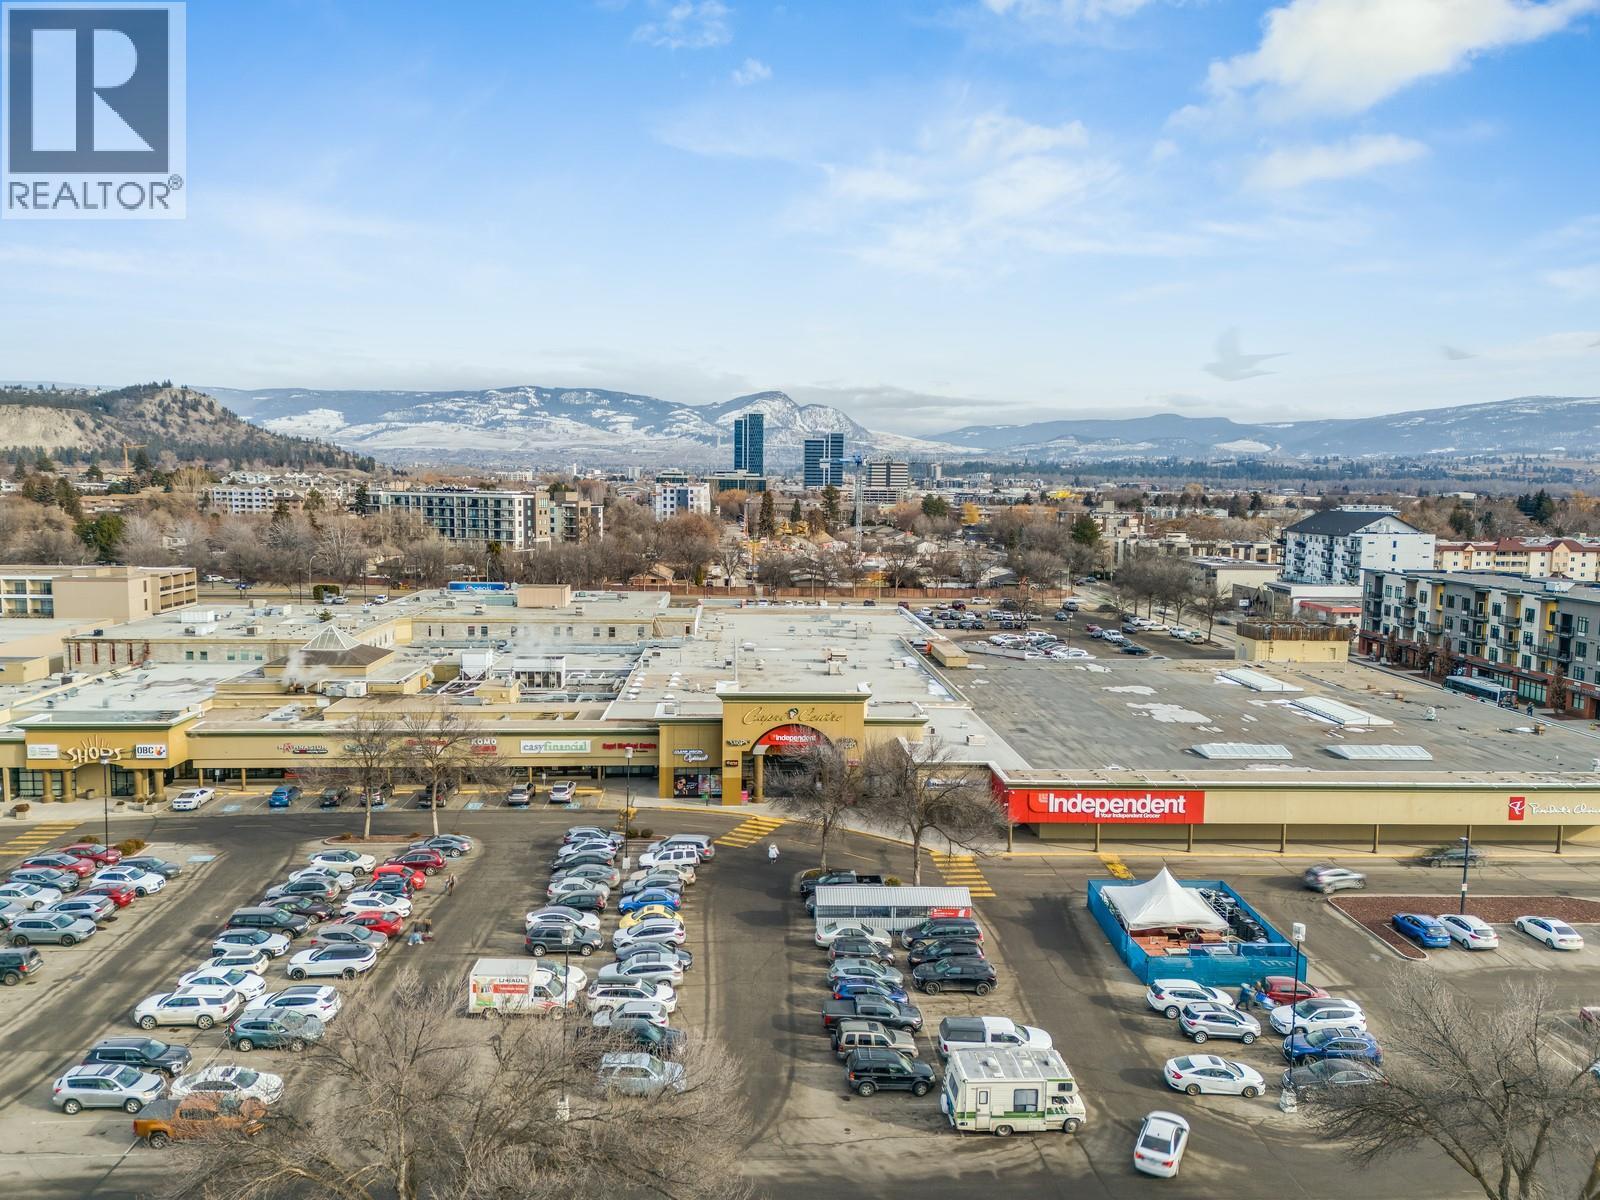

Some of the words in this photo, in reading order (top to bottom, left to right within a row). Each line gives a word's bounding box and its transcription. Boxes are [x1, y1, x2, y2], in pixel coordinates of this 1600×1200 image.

[743, 706, 784, 726] Capri
[798, 707, 842, 722] Centre
[66, 746, 125, 762] SHOPS
[136, 746, 154, 754] OBC
[523, 741, 587, 753] easyfinancial
[1048, 793, 1186, 818] Independent
